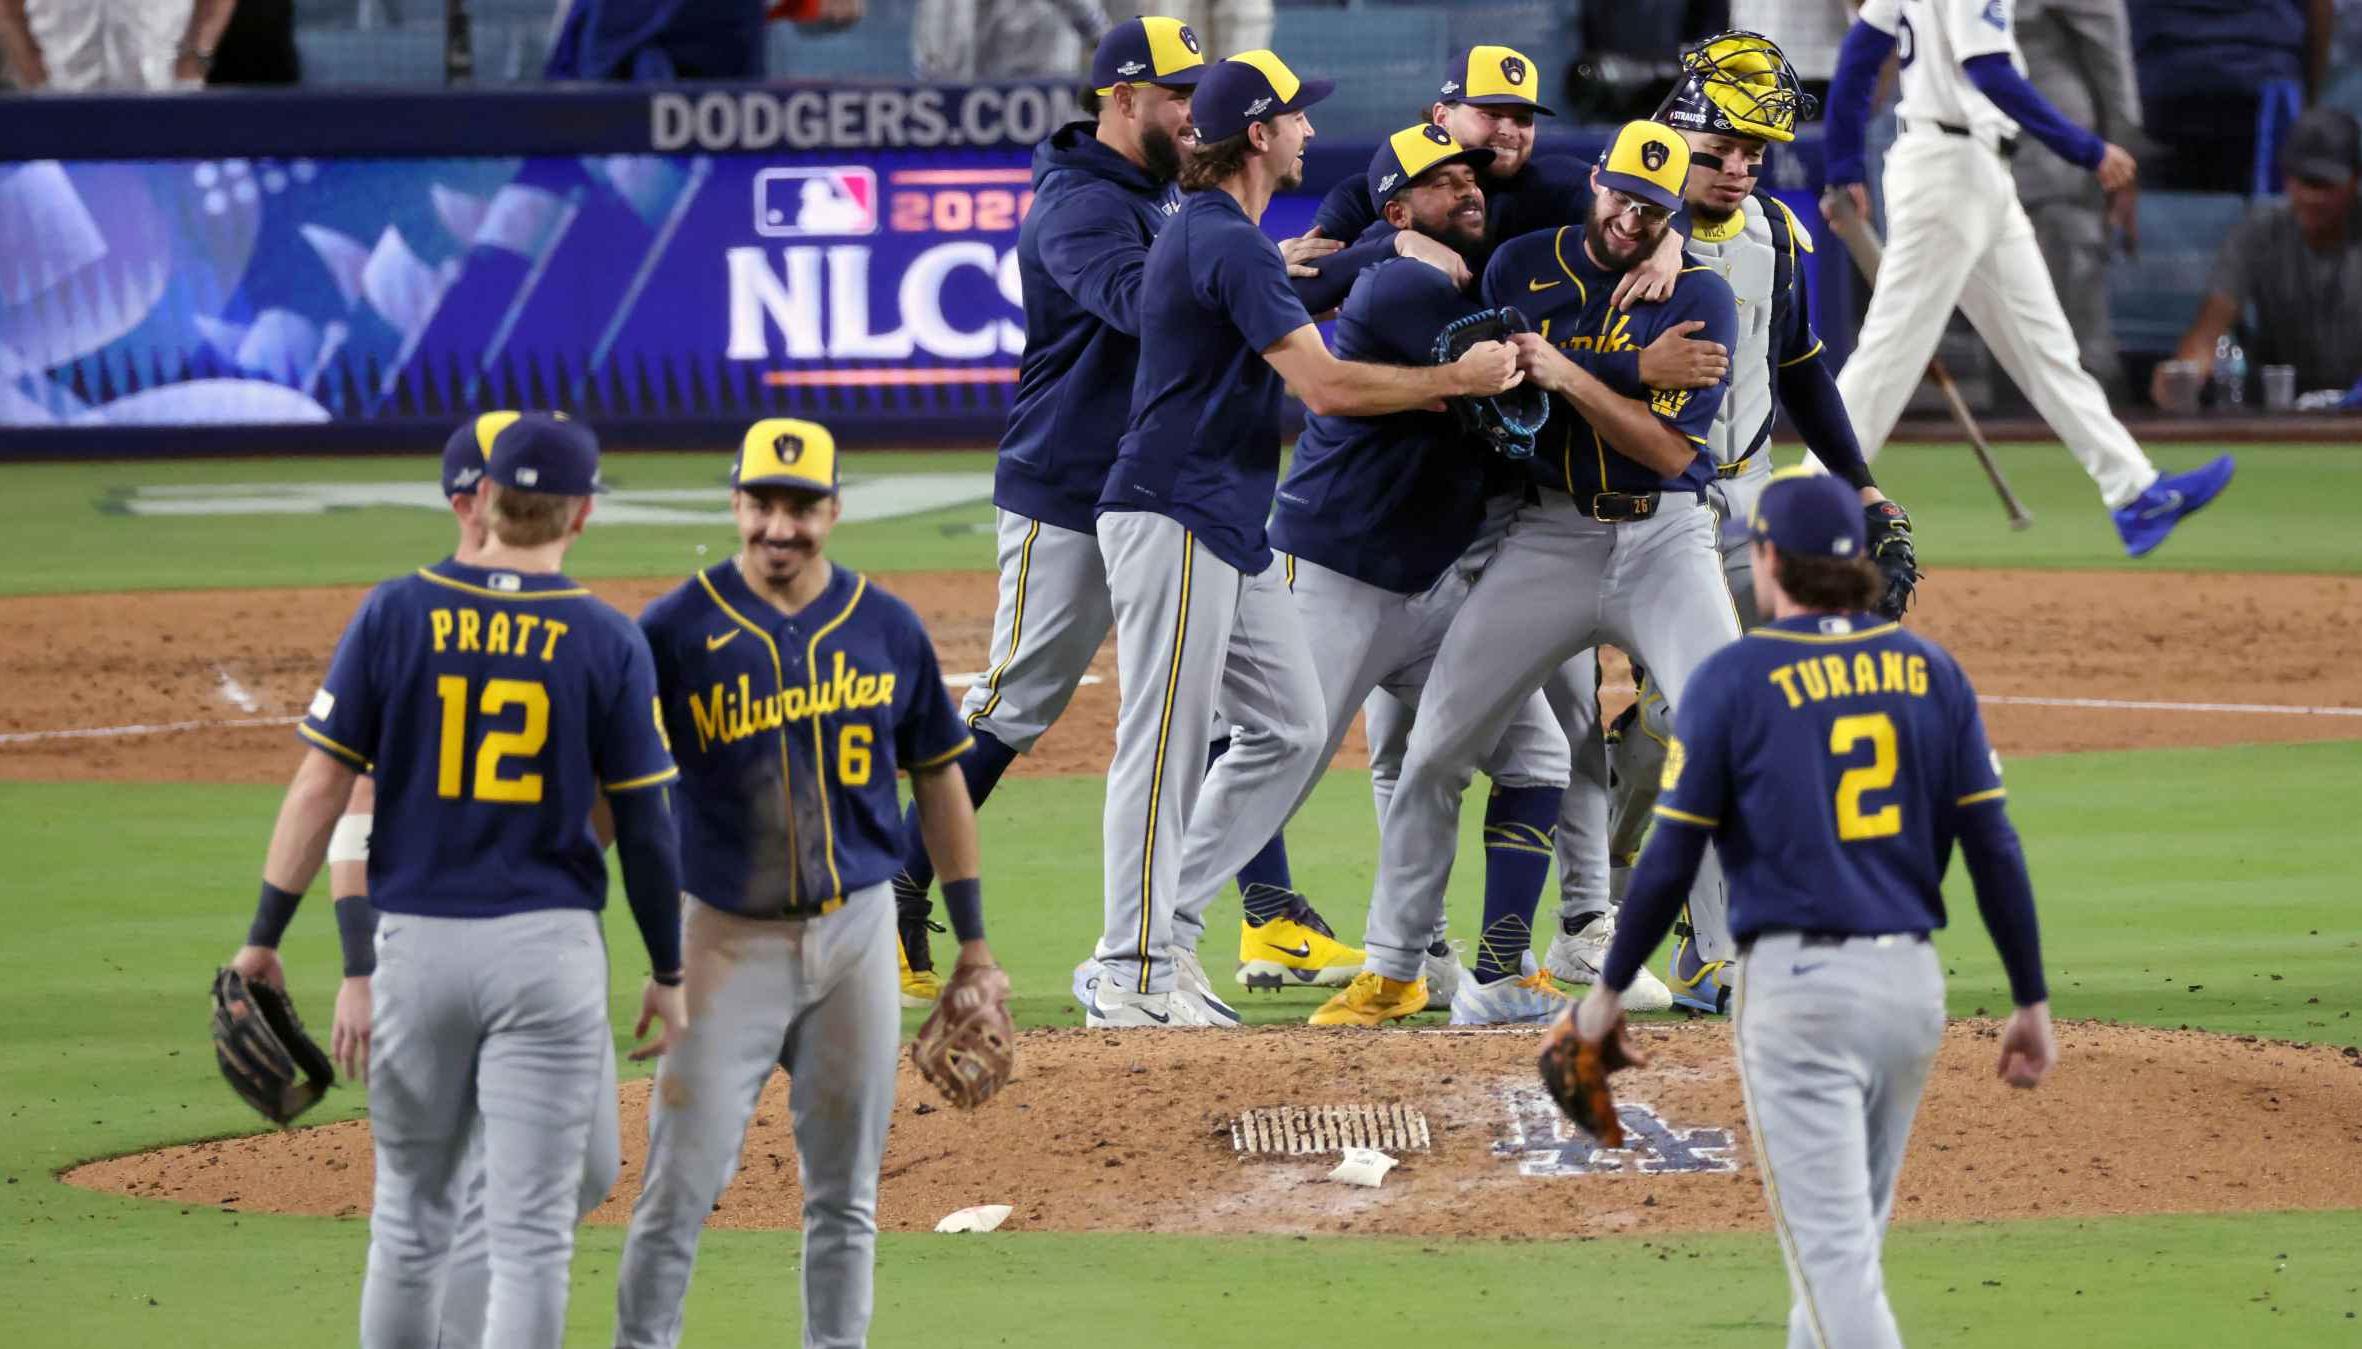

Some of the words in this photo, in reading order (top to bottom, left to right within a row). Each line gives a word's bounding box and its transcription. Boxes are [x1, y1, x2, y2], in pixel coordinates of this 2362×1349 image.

[1674, 111, 1707, 124] STRAUSS
[1634, 499, 1648, 514] 26
[430, 608, 569, 662] PRATT
[689, 651, 896, 752] Milwaukee
[1769, 650, 1928, 709] TURANG
[437, 673, 550, 803] 12
[838, 724, 873, 786] 6
[1829, 712, 1901, 841] 2
